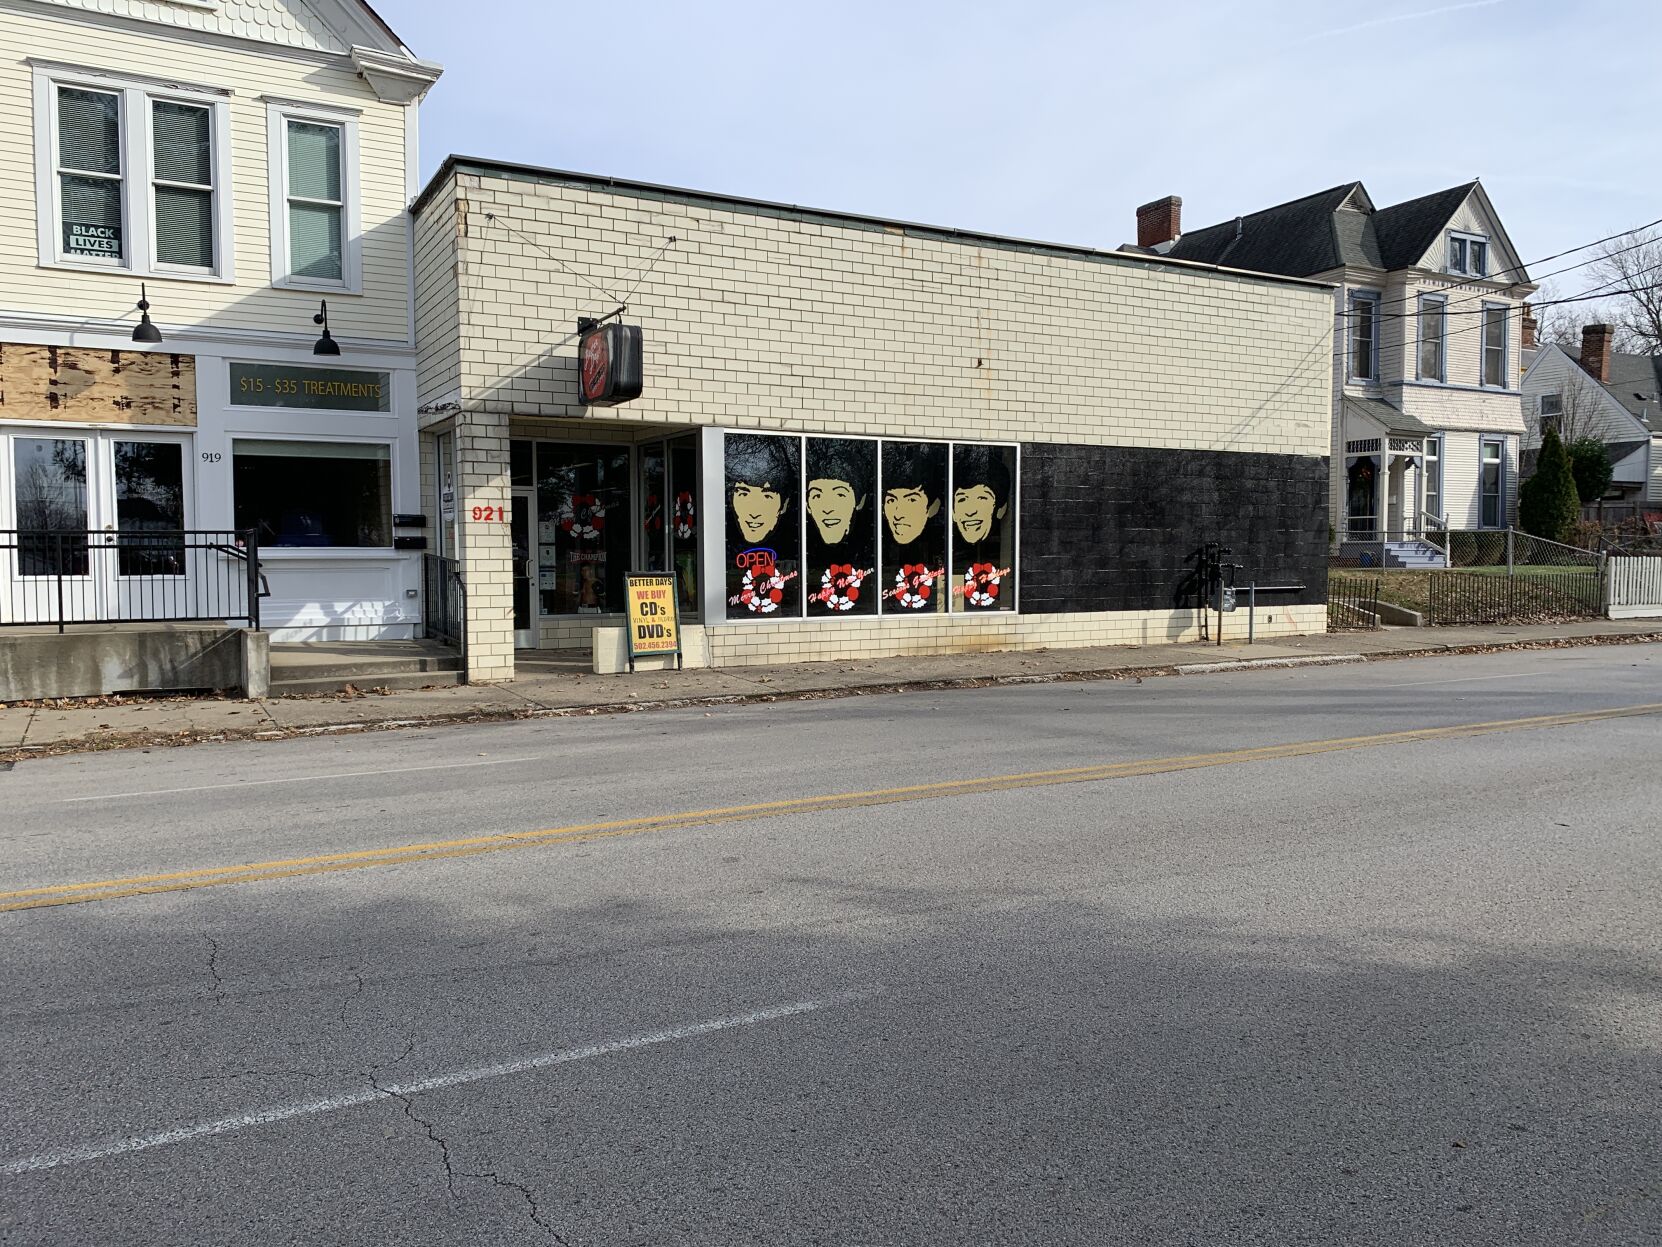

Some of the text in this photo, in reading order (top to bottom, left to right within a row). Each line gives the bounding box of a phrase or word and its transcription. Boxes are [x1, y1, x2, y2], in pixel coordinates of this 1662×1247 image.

[73, 225, 114, 238] BLACK
[75, 237, 113, 250] LIVES
[240, 376, 263, 392] $15
[275, 378, 297, 394] $35
[302, 380, 381, 398] TREATMENTS
[201, 452, 222, 463] 919
[472, 505, 504, 522] 921
[736, 552, 774, 568] OPEN
[629, 577, 673, 587] BETTER DAYS
[808, 586, 835, 603] Happy
[856, 567, 875, 580] Year
[636, 589, 667, 600] WE BUY
[728, 591, 756, 606] Merry
[639, 601, 667, 617] CD's
[637, 623, 673, 640] DVD's
